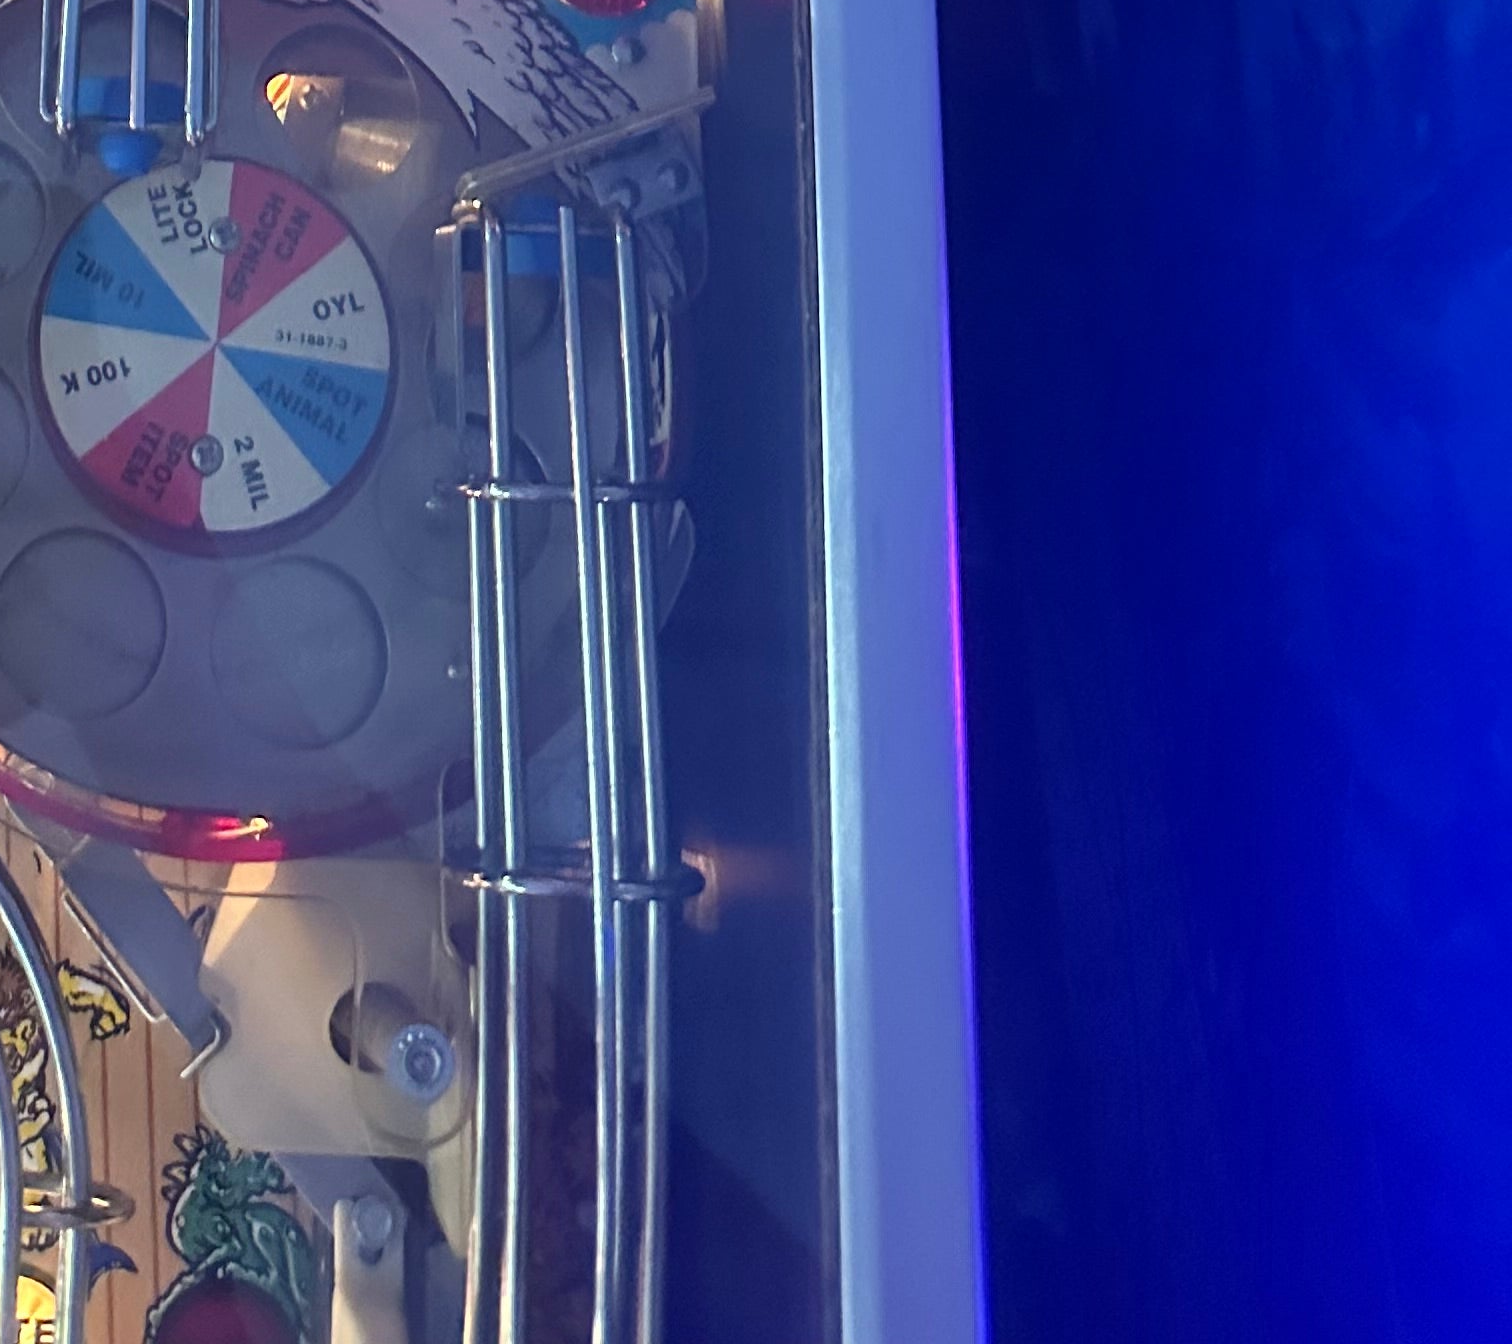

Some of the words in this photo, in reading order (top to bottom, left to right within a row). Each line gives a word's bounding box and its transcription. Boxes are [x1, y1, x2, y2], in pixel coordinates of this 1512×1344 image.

[147, 183, 180, 244] LITE
[172, 181, 210, 256] LOCK
[274, 205, 312, 261] CAN
[225, 191, 287, 305] SPINACH
[312, 291, 366, 320] OYL
[59, 373, 80, 396] K
[88, 357, 132, 388] 100
[301, 367, 369, 416] SPOT
[254, 375, 349, 443] ANIMAL
[233, 435, 256, 455] 2
[240, 459, 272, 512] MIL
